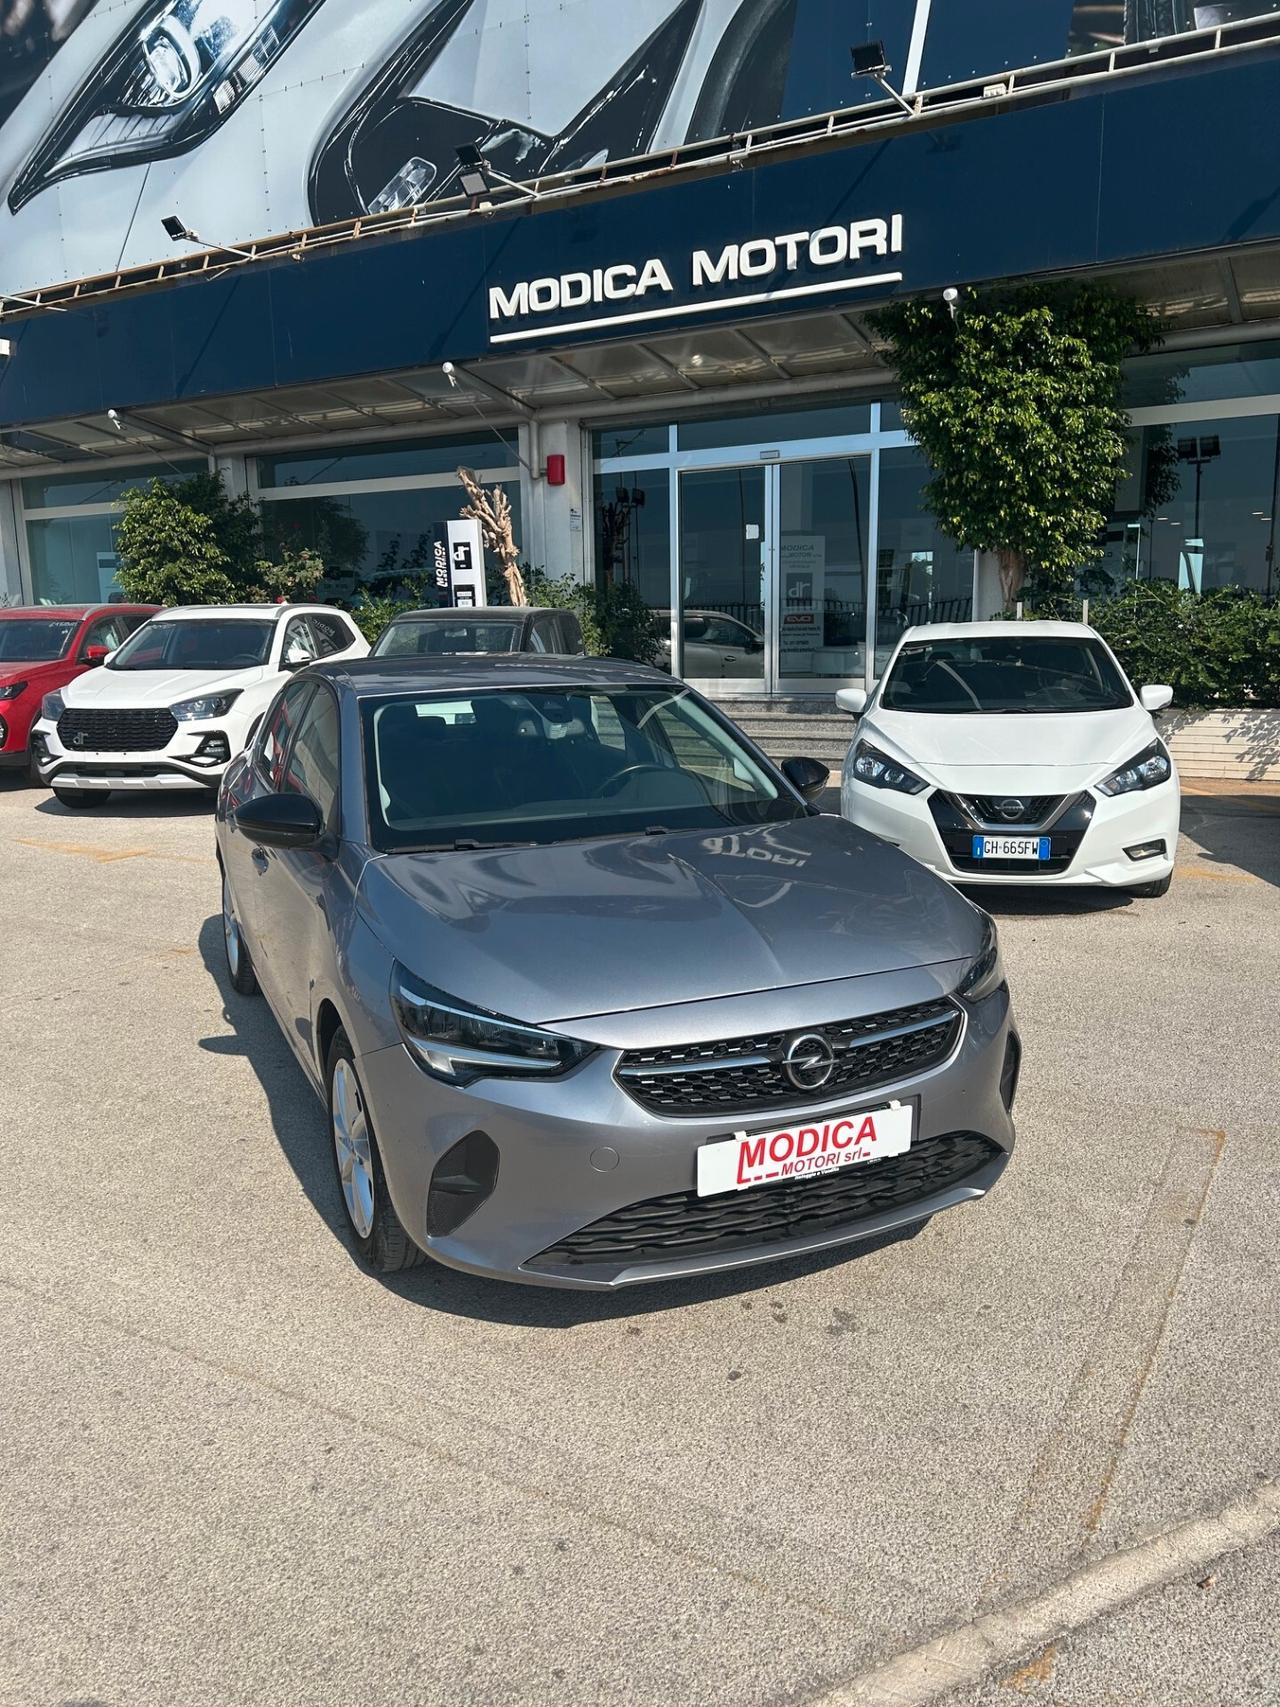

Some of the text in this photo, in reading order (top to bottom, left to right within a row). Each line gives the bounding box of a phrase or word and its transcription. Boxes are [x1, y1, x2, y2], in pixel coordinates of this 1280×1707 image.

[489, 214, 903, 320] MODICA MOTORI
[434, 540, 447, 587] MODICA
[788, 581, 811, 599] dr
[737, 1116, 878, 1170] MODICA
[780, 1147, 863, 1177] MOTORI srl
